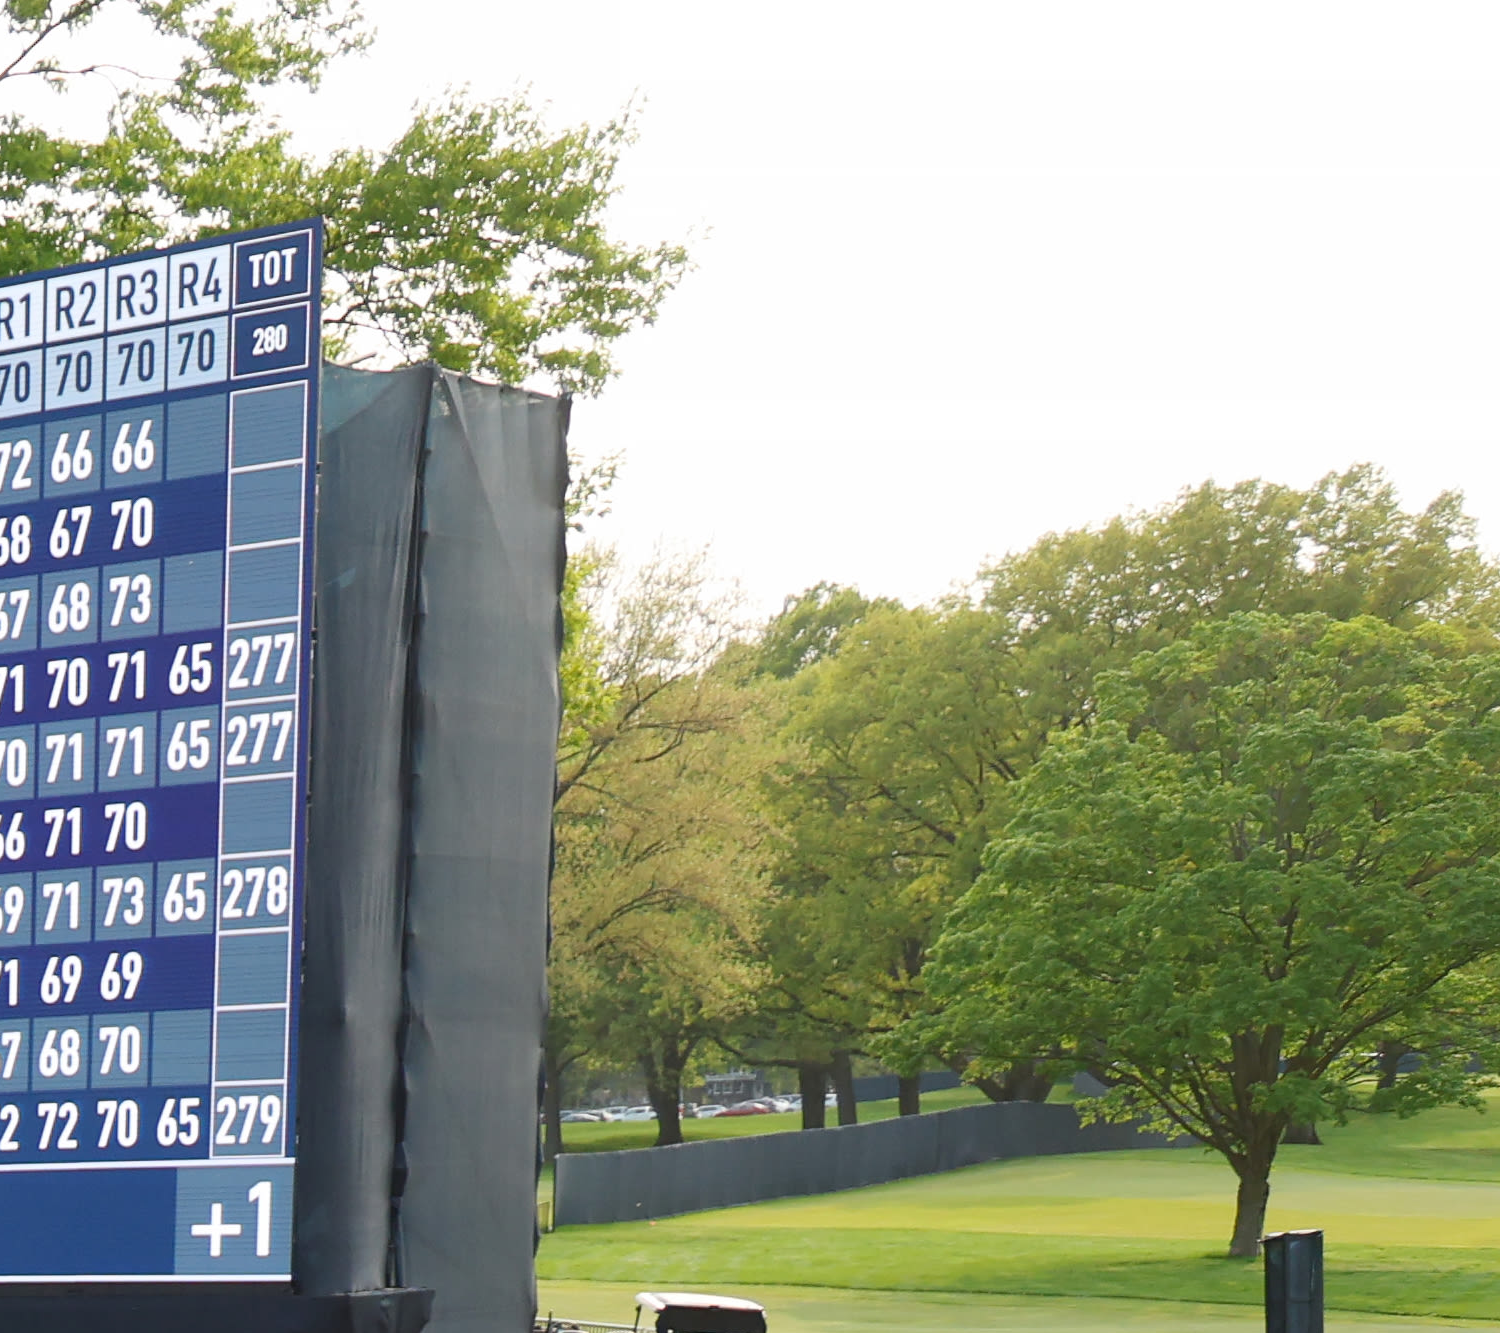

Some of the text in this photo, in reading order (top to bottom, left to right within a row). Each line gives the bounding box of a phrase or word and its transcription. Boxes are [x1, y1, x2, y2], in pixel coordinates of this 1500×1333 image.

[55, 281, 97, 332] R2
[115, 269, 159, 321] R3
[178, 257, 222, 309] R4
[248, 247, 298, 289] TOT
[56, 349, 93, 397] 70
[117, 338, 155, 386] 70
[177, 327, 216, 376] 70
[252, 323, 288, 356] 280
[51, 429, 93, 483] 66
[112, 419, 155, 474] 66
[228, 632, 295, 689] 277
[226, 710, 293, 766] 277
[222, 865, 288, 919] 278
[37, 1102, 79, 1150] 72
[97, 1100, 138, 1149] 70
[156, 1097, 200, 1147] 65
[215, 1094, 281, 1145] 279
[190, 1181, 272, 1257] +1
